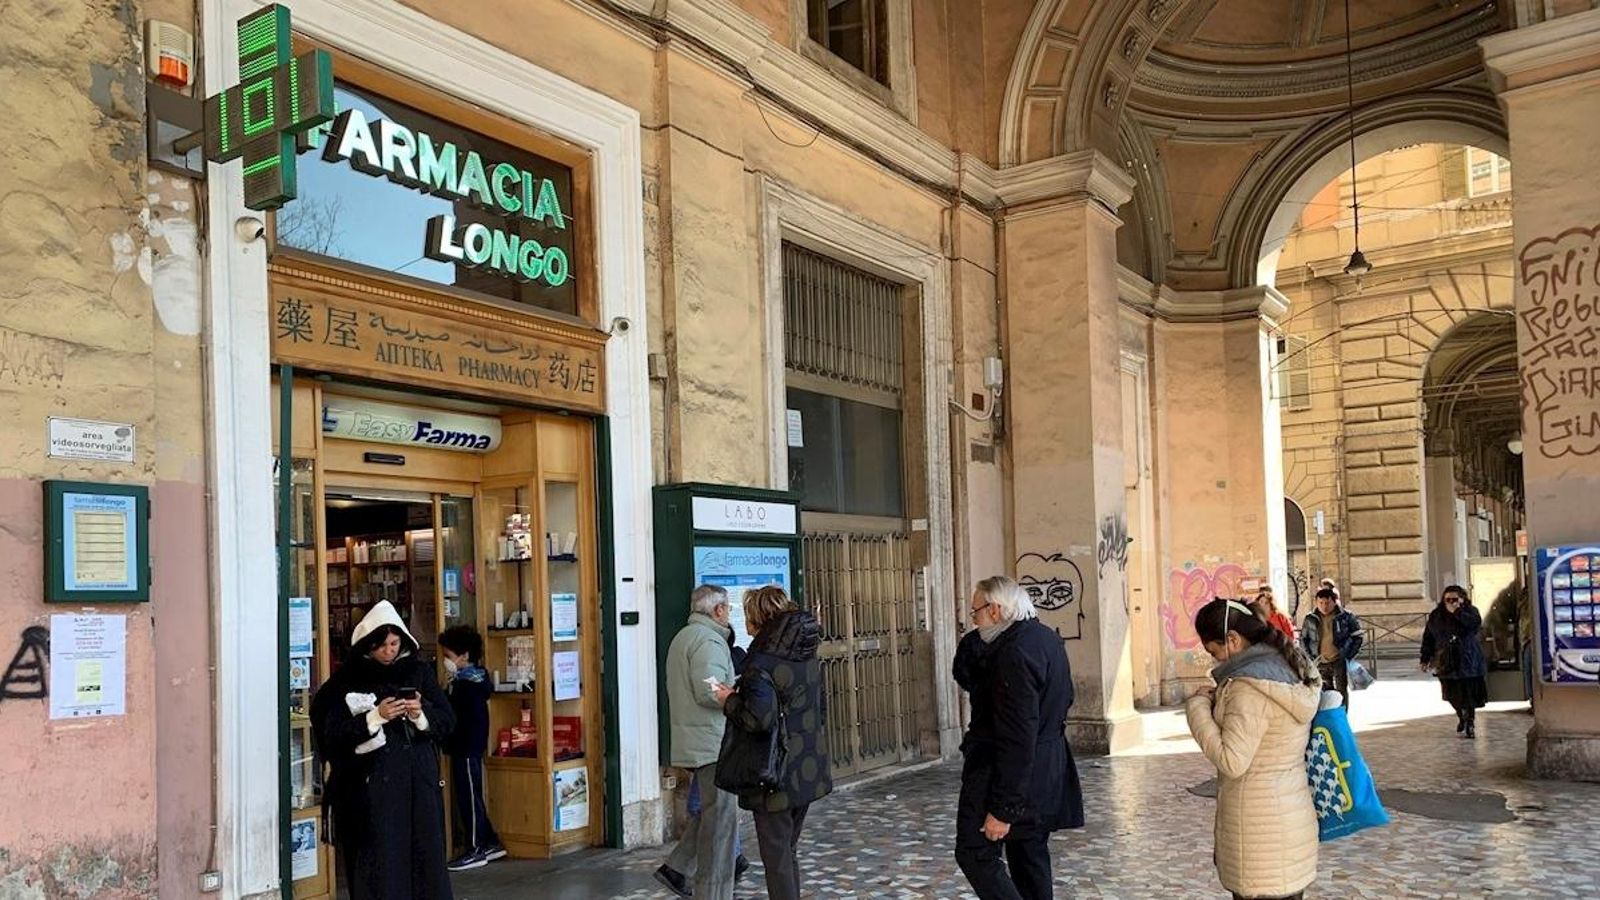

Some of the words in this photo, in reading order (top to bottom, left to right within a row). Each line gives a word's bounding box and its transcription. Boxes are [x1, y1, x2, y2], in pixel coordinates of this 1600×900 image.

[440, 214, 569, 287] LONGO
[277, 297, 360, 351] 藥屋
[458, 356, 541, 389] PHARMACY
[549, 351, 597, 393] 药店
[52, 437, 132, 452] videosorvegliata
[82, 432, 104, 440] area
[724, 504, 767, 521] LABO
